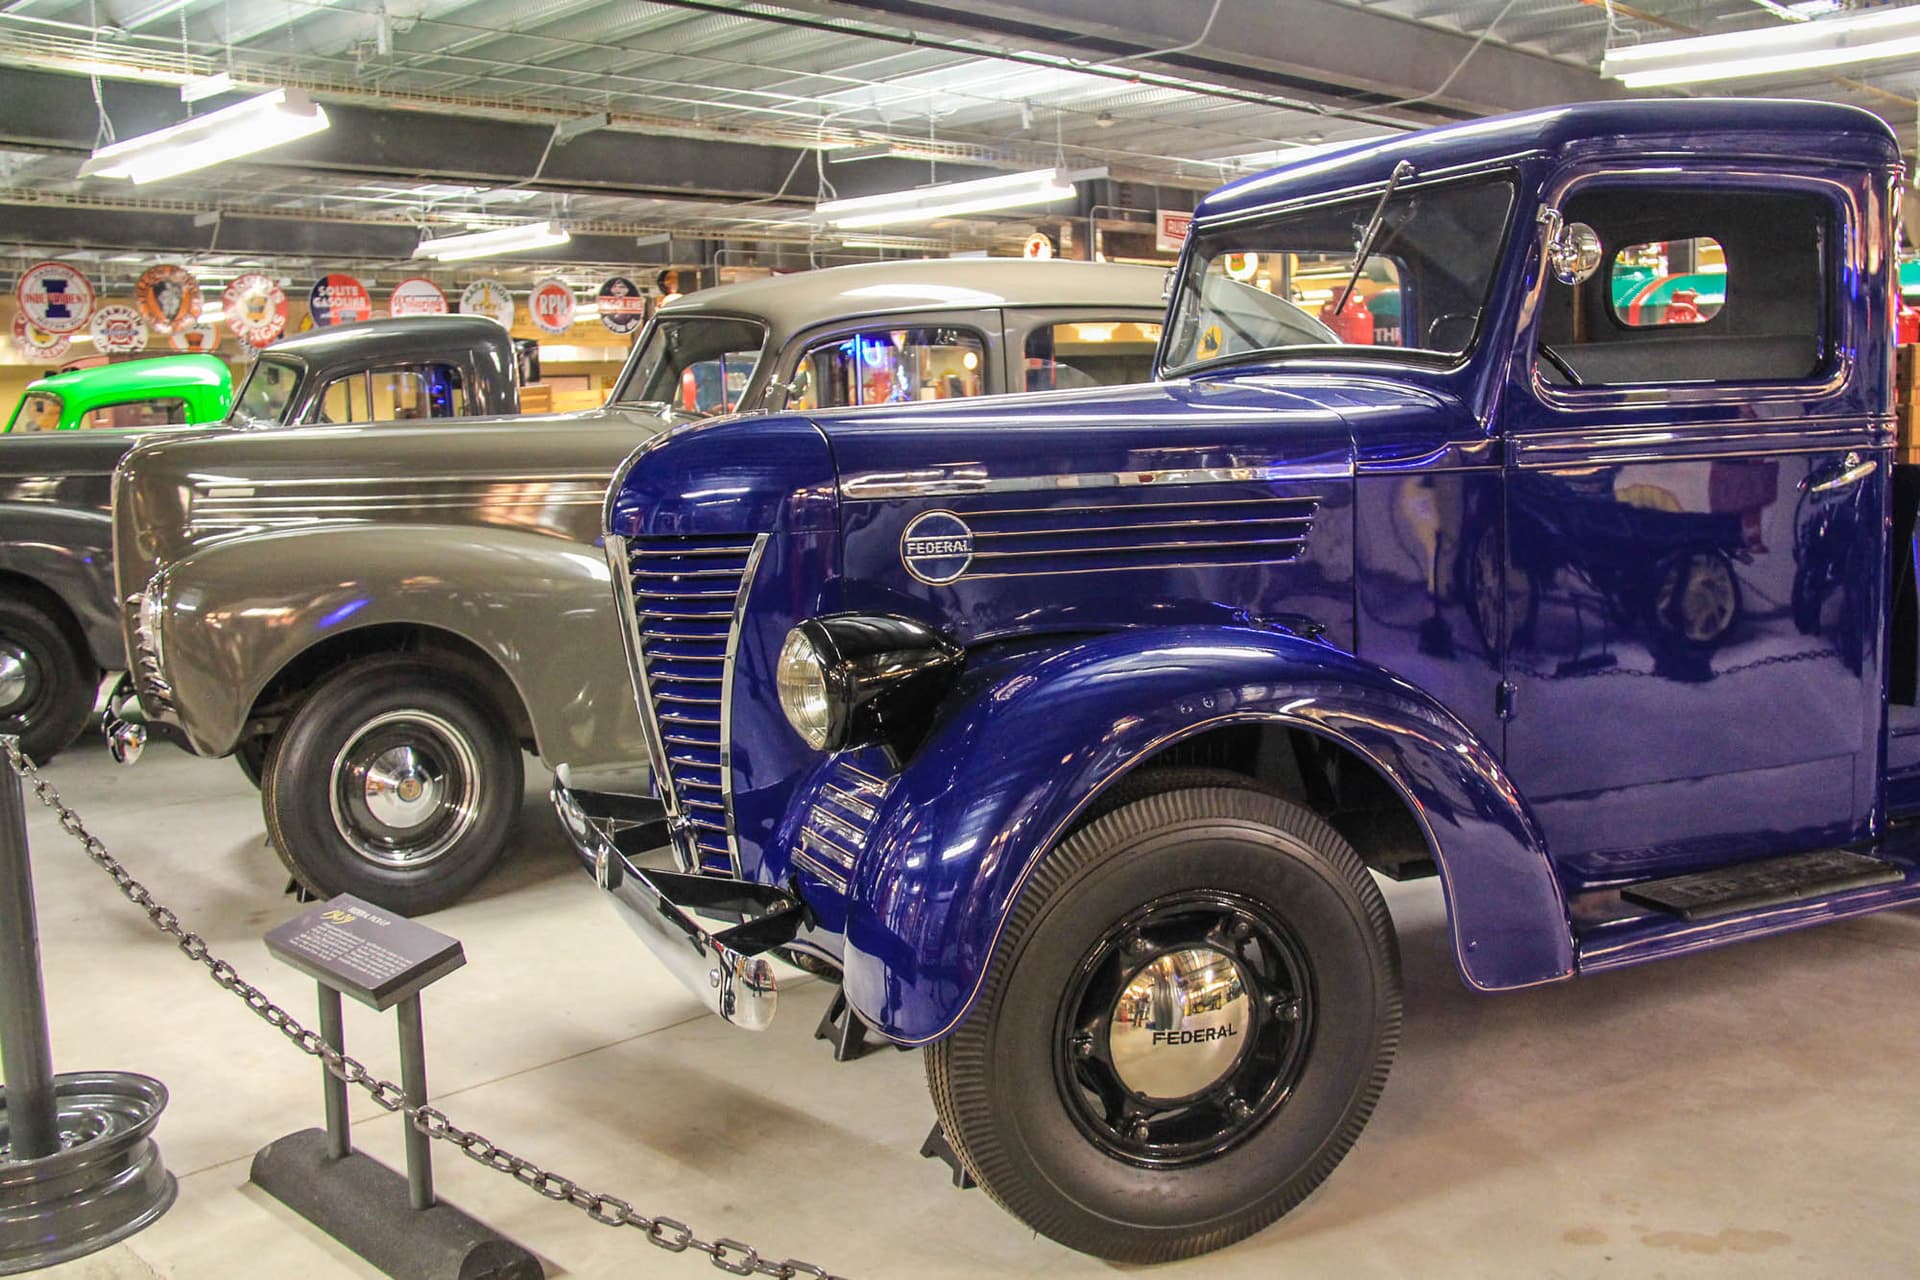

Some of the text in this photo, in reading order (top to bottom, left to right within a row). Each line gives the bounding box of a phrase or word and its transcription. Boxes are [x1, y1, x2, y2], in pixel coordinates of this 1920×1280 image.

[318, 286, 358, 296] SOLITE
[313, 297, 366, 307] GASOLINE
[540, 294, 569, 315] RPM
[906, 540, 973, 555] FEDERAL
[1152, 1023, 1237, 1045] FEDERAL
